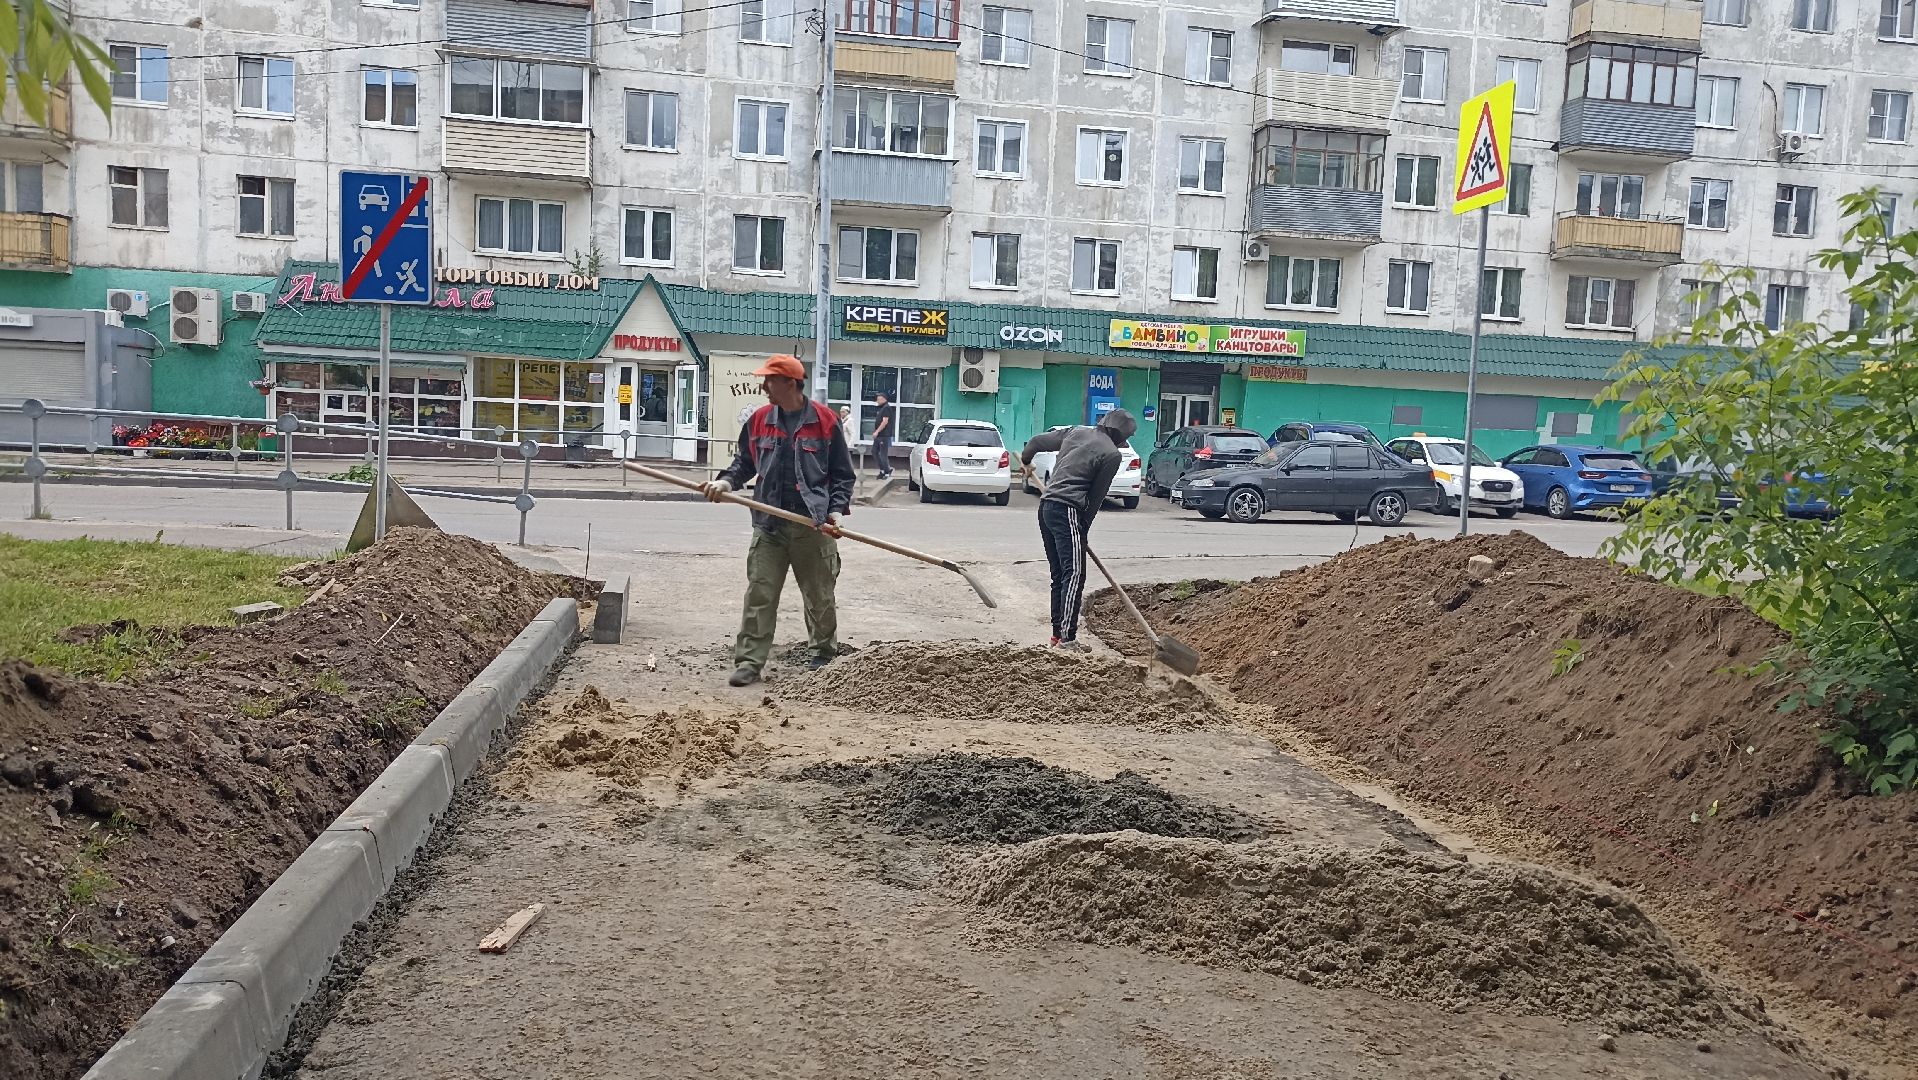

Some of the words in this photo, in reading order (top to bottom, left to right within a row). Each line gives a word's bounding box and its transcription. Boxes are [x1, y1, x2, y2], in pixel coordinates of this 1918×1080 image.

[435, 267, 549, 287] ТОРГОВЫЙ
[555, 274, 599, 291] ДОМ
[880, 324, 946, 335] ИНСТРУМЕНТ
[1000, 325, 1063, 344] OZON
[1123, 326, 1198, 343] БАМБИНО
[1230, 328, 1286, 341] ИГРУШКИ
[614, 334, 682, 353] ПРОДУКТЫ
[1216, 339, 1297, 354] КАНЦТОВАРЫ
[1249, 365, 1309, 381] ПРОДУКТЫ
[1089, 374, 1114, 390] ВОДА
